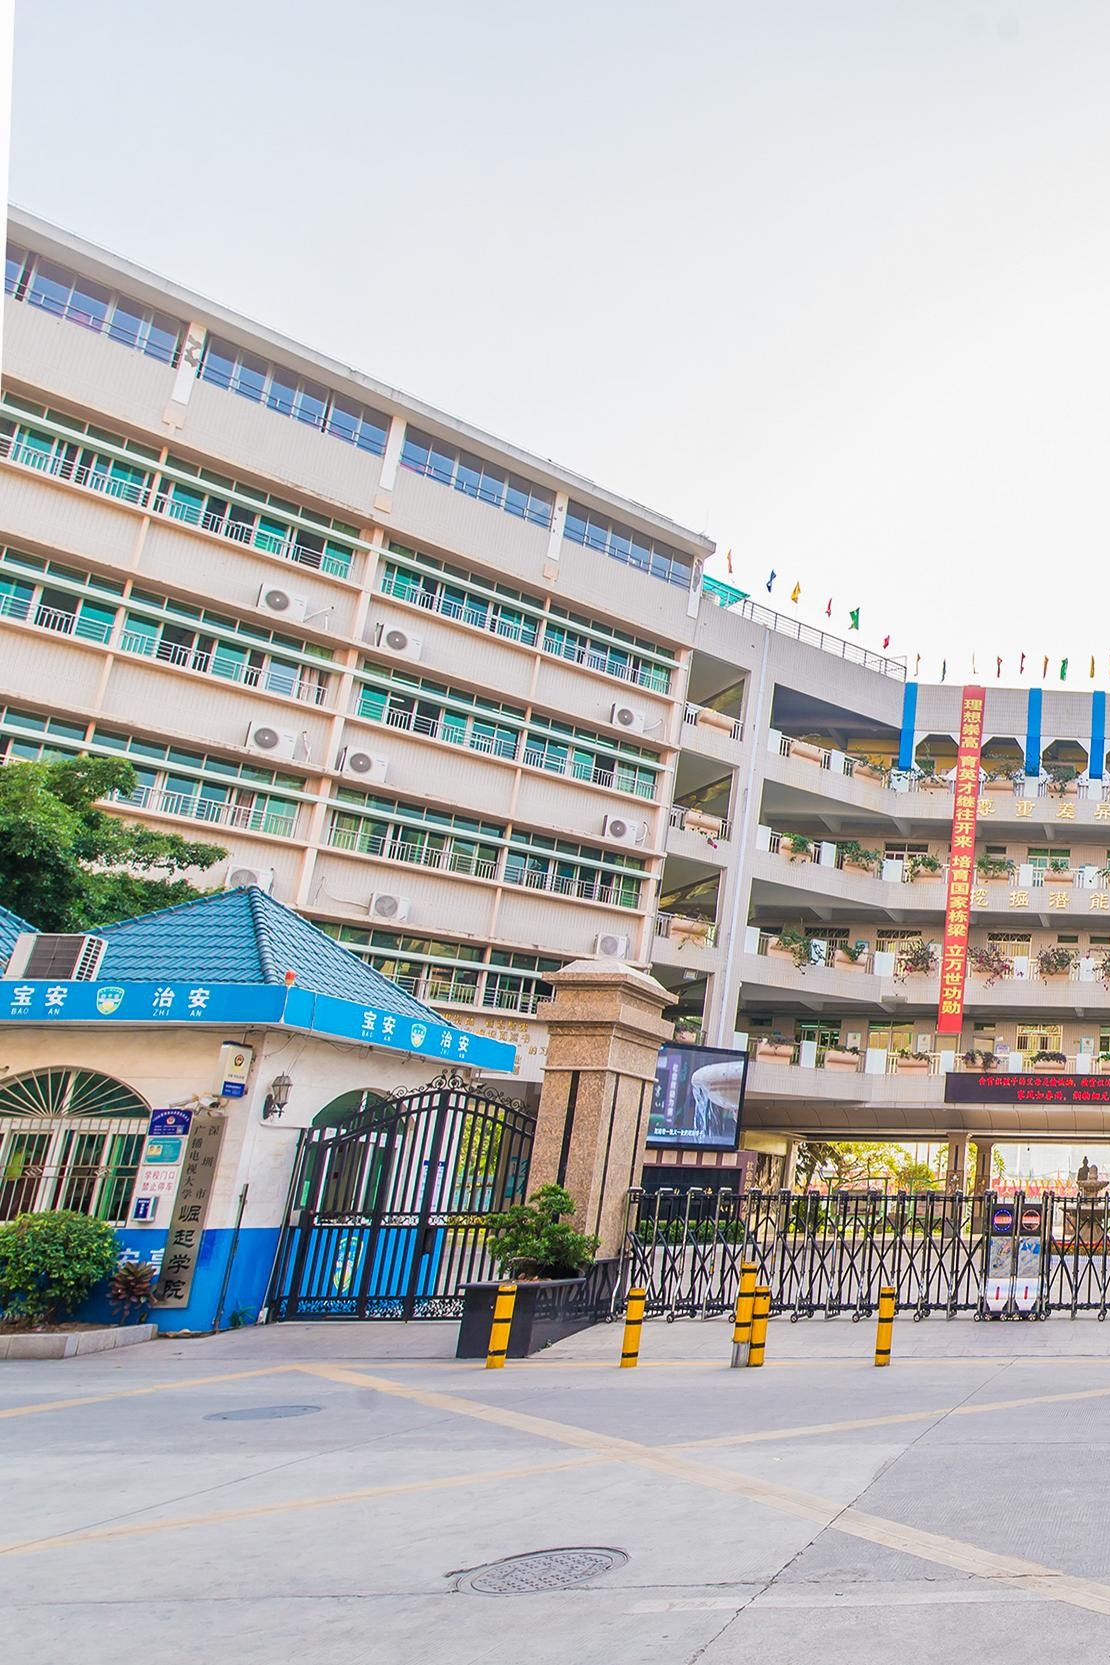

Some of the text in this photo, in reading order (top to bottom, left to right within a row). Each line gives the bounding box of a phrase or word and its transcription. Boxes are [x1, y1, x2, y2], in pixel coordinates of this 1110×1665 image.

[941, 699, 983, 1015] 理想崇高 育英才继往开来 培育国家栋梁 立万世功勋
[10, 985, 210, 1009] 宝安 治安
[11, 1008, 30, 1016] BAO
[47, 1008, 60, 1016] AN
[189, 1009, 203, 1018] AN
[361, 1011, 470, 1053] 宝安 治安
[163, 1204, 202, 1300] 崛起学院
